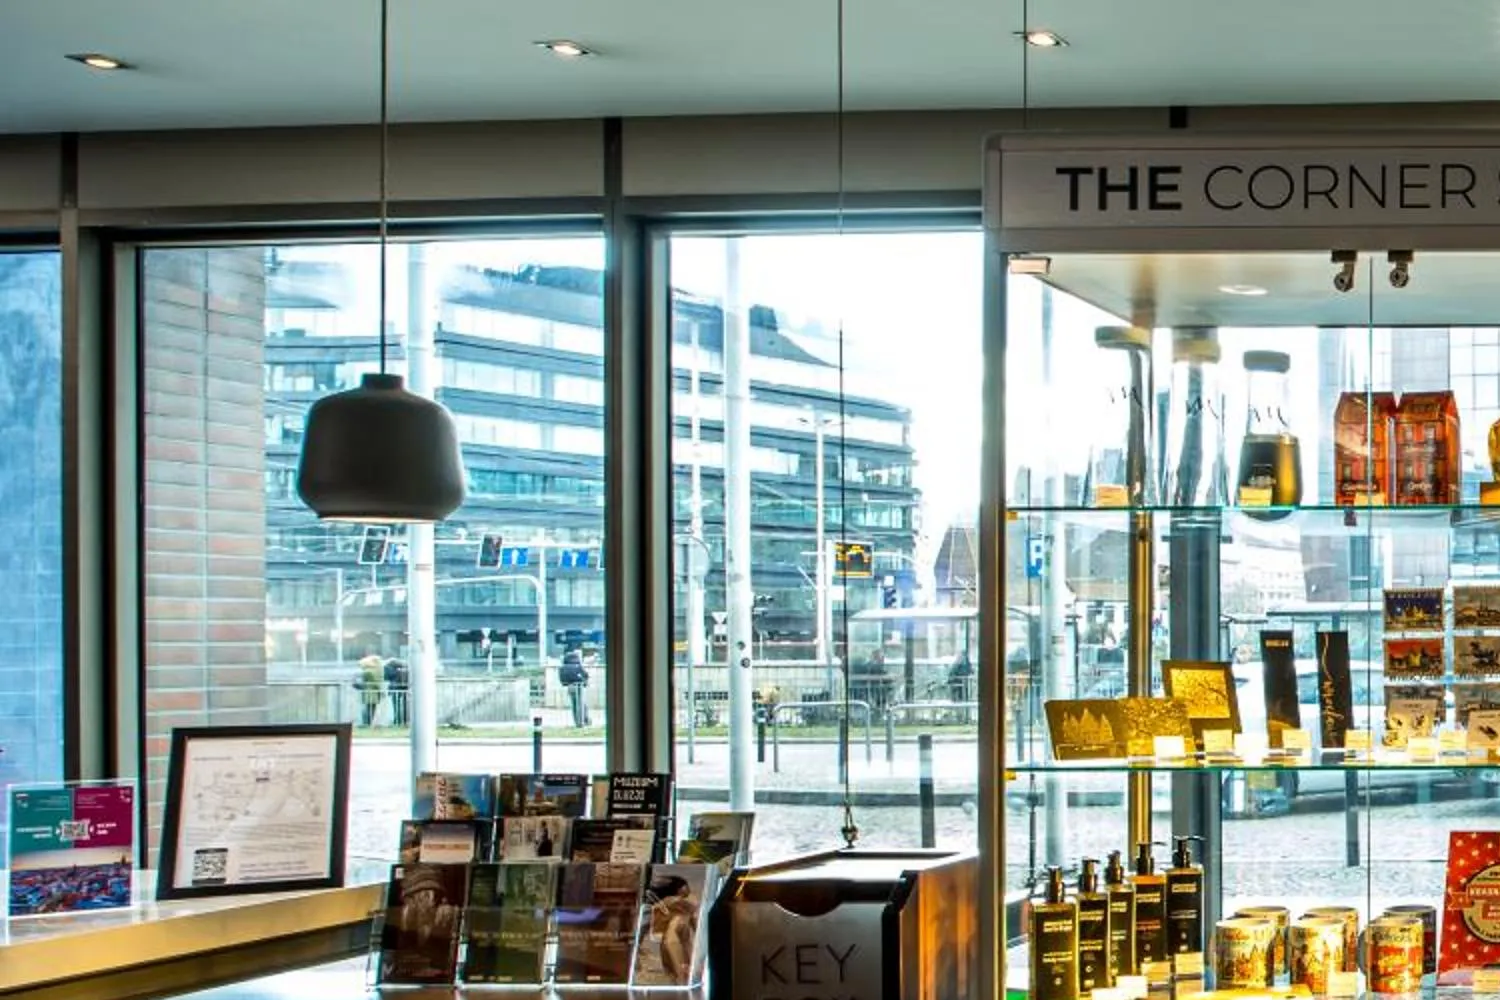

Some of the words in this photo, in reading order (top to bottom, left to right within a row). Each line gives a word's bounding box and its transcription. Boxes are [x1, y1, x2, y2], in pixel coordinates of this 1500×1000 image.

[1056, 165, 1182, 211] THE
[1204, 164, 1476, 210] CORNER
[761, 943, 858, 986] KEY
